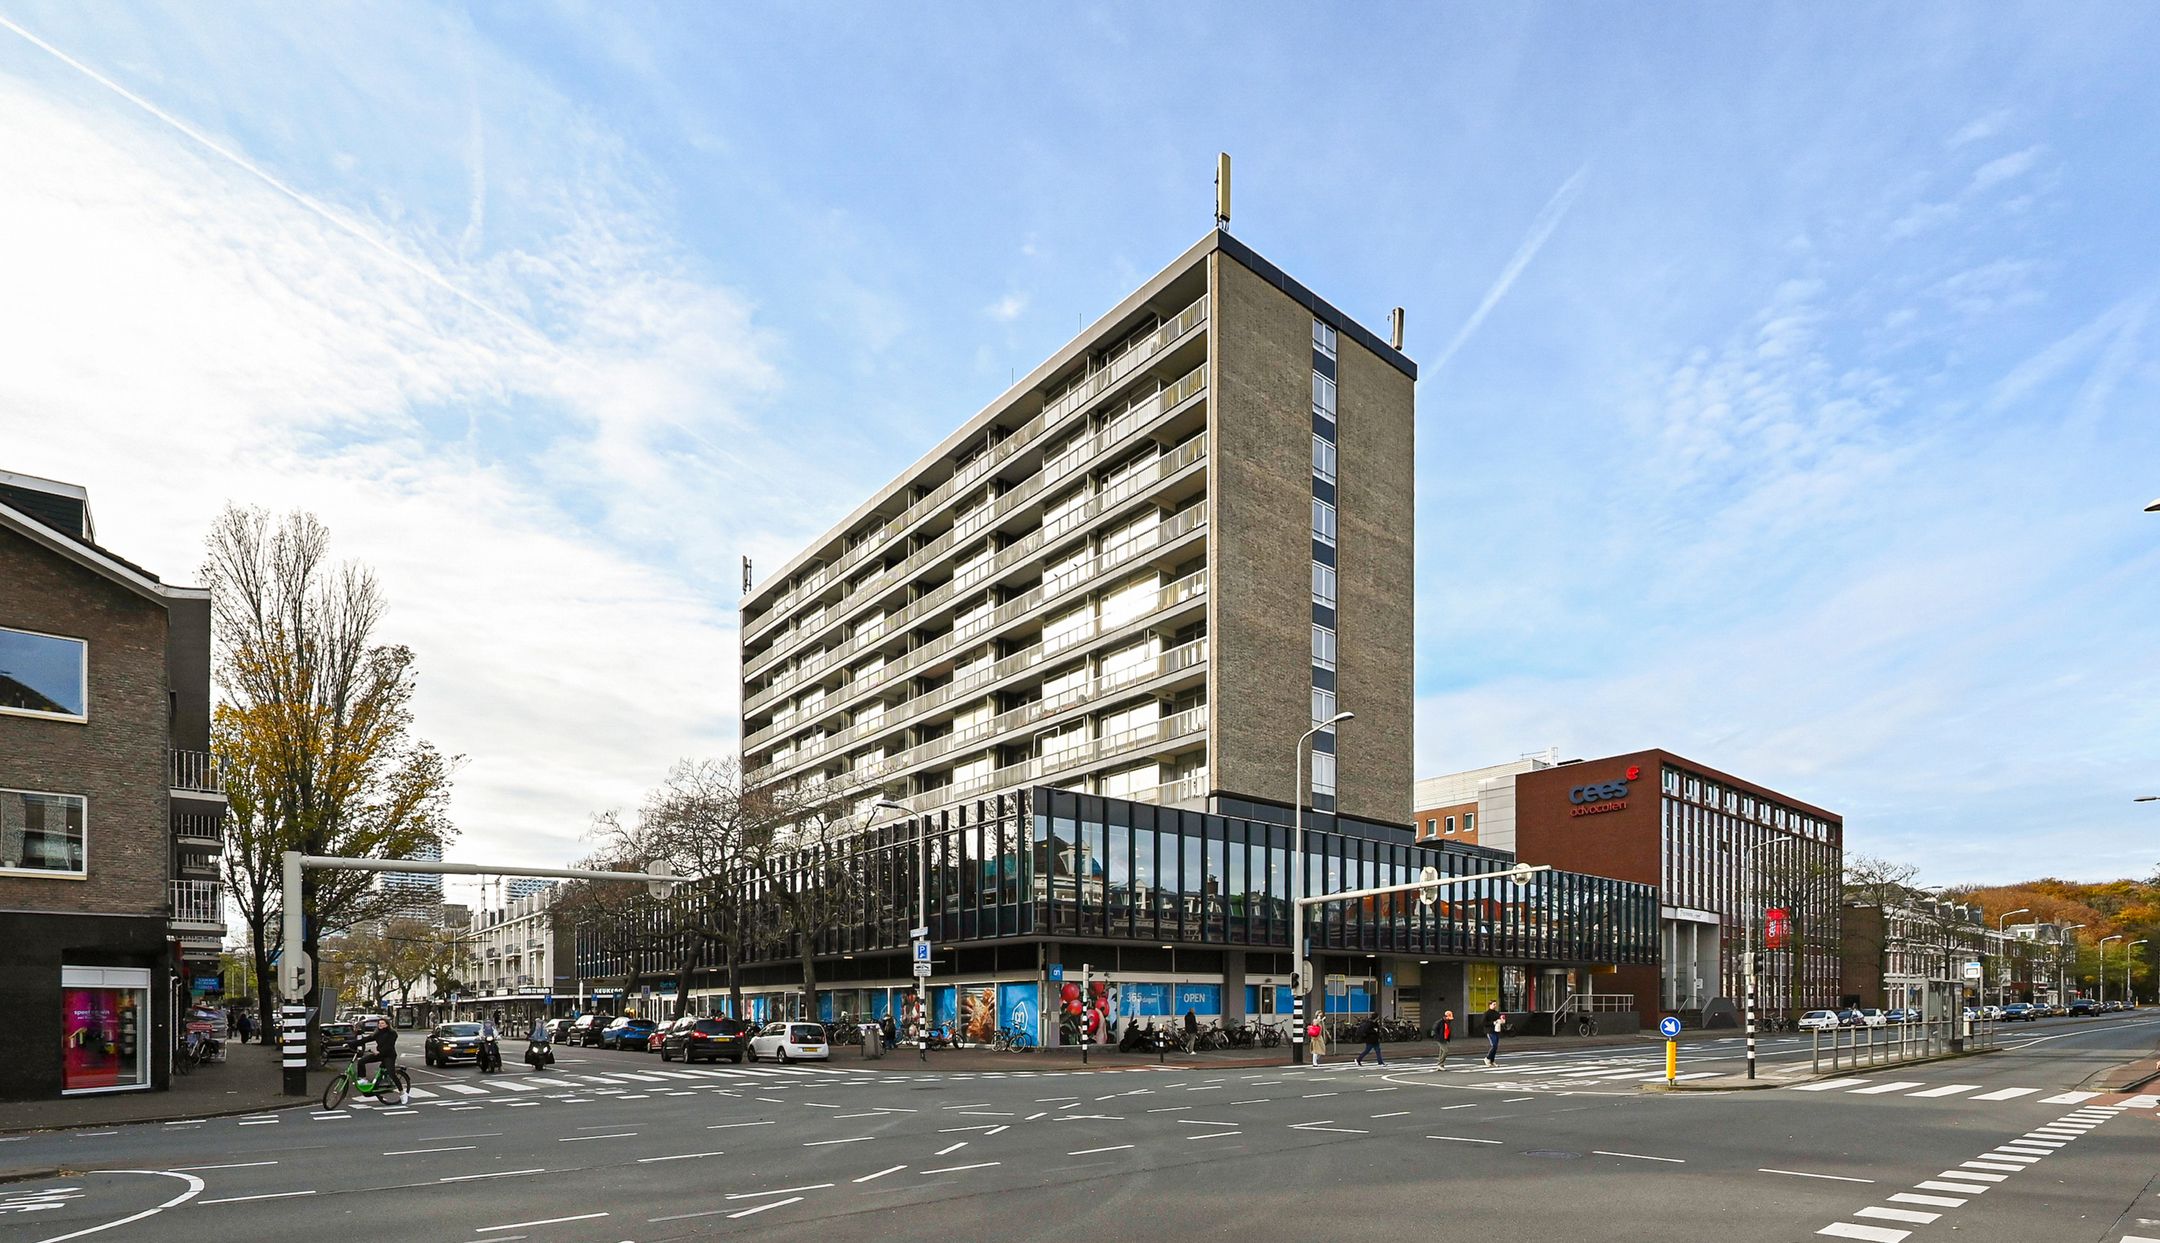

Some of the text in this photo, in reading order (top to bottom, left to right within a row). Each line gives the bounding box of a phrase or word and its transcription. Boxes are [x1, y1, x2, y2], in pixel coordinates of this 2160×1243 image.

[1569, 779, 1629, 805] cees
[1569, 801, 1627, 816] advocaten
[1126, 992, 1142, 1003] 365
[1183, 993, 1206, 1003] OPEN
